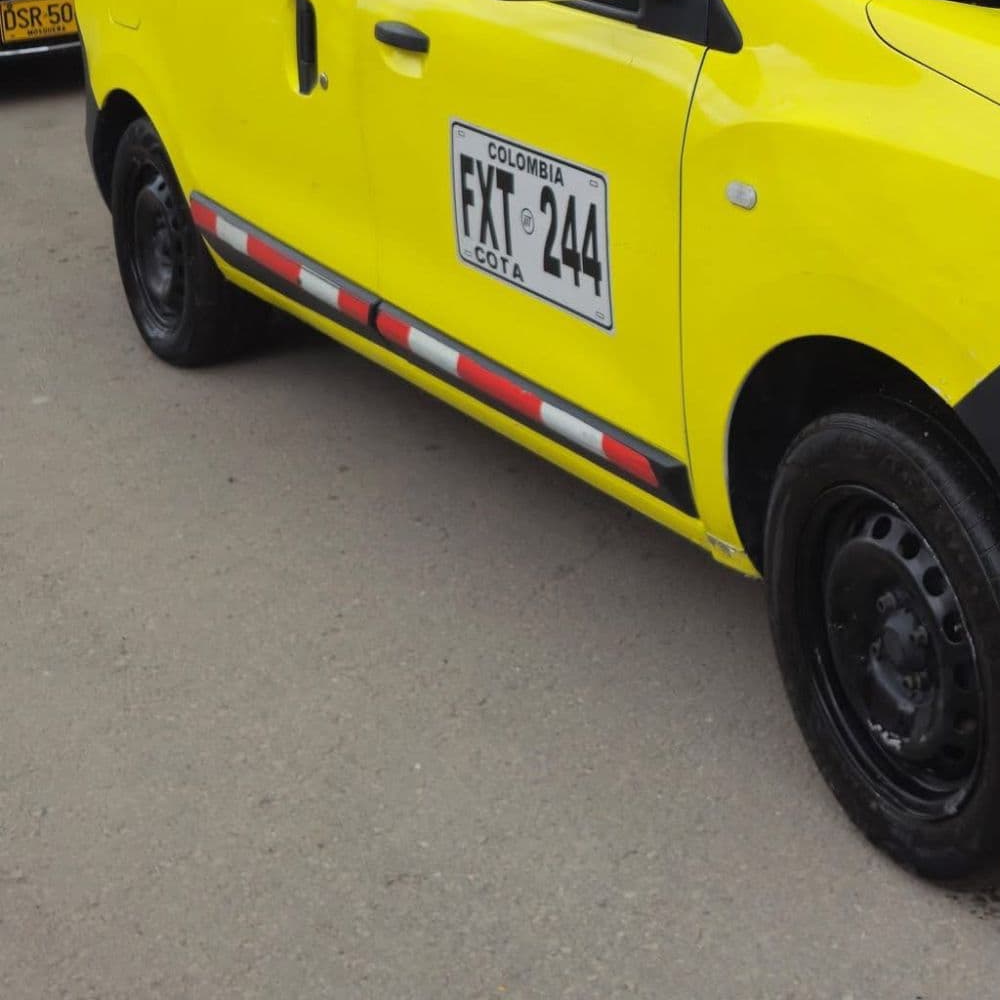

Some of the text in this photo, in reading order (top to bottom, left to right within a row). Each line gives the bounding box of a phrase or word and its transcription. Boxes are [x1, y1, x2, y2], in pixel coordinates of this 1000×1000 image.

[4, 7, 42, 30] DSR
[488, 142, 564, 187] COLOMBIA
[460, 153, 602, 297] FXT 244
[475, 246, 524, 282] COTA
